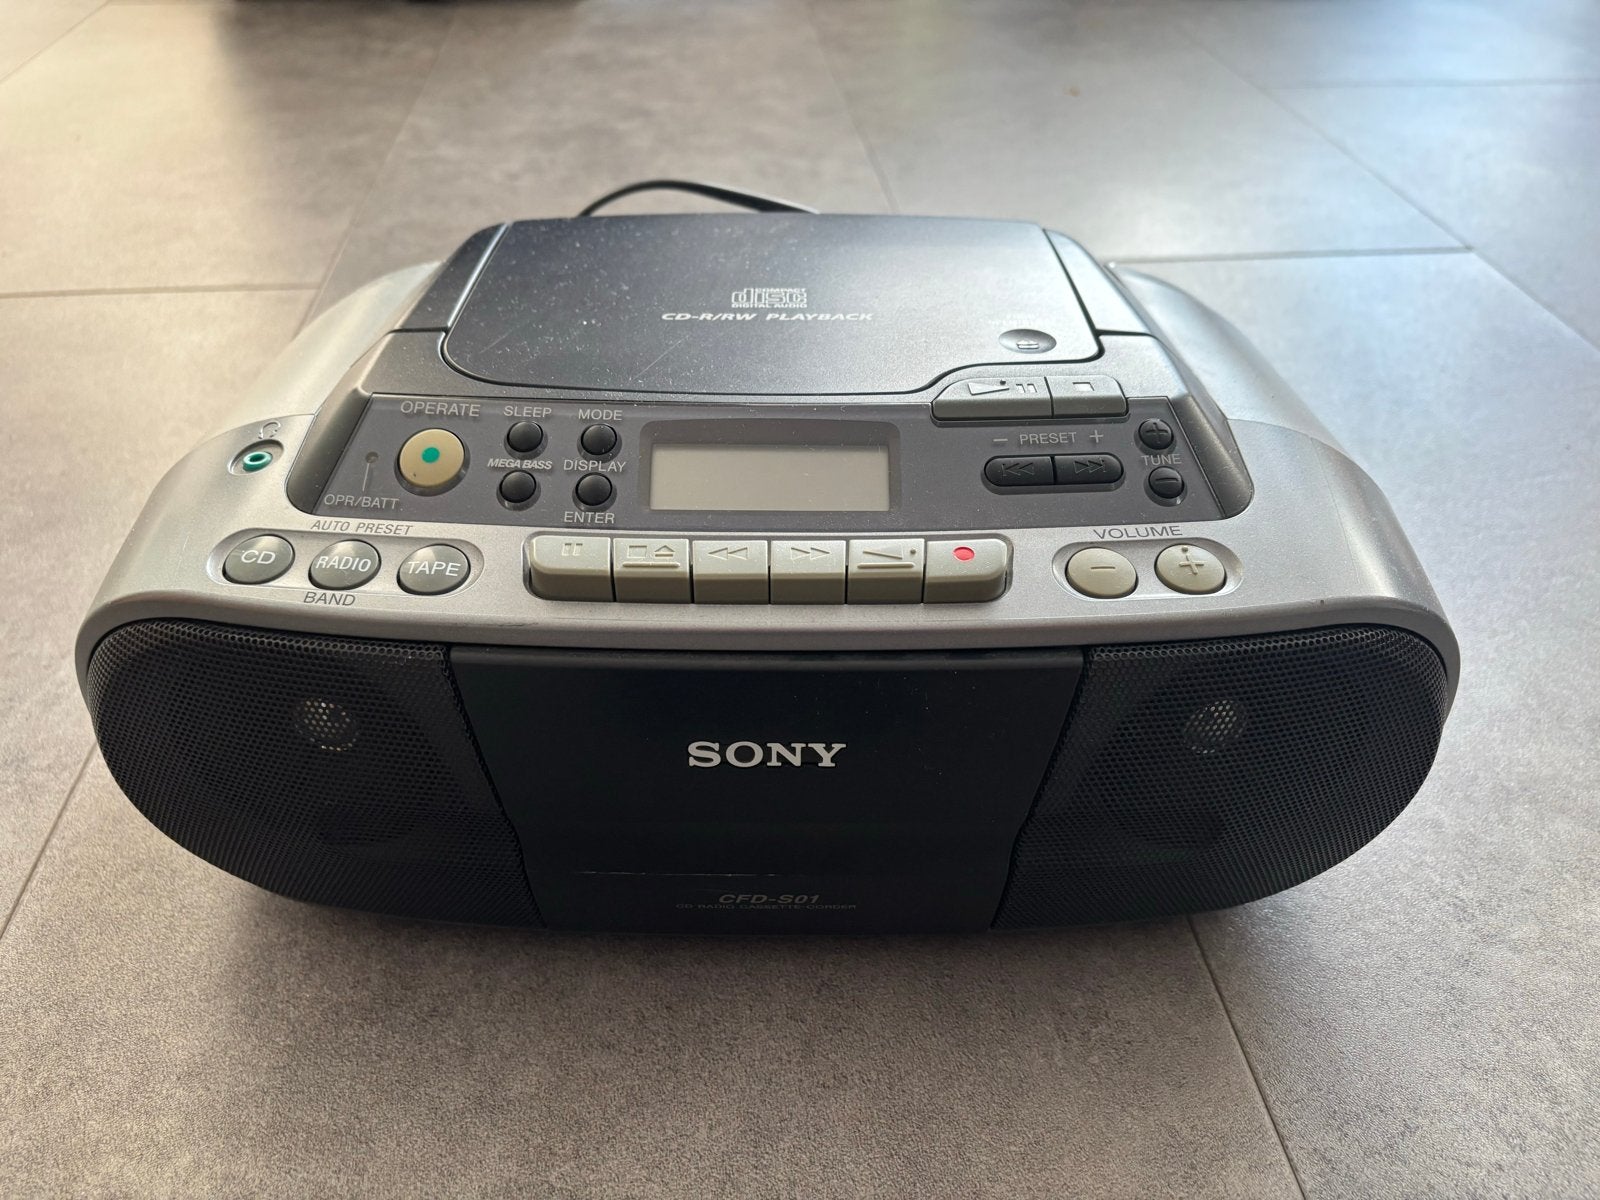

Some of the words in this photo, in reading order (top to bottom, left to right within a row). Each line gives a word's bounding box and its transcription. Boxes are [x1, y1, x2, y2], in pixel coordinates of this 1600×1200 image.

[661, 313, 757, 321] CD-R/RW
[766, 313, 874, 321] PLAYBACK
[400, 401, 481, 417] OPERATE
[503, 405, 552, 418] SLEEP
[578, 409, 623, 421] MODE
[1019, 432, 1077, 445] PRESET
[487, 458, 522, 469] MEGA
[522, 459, 553, 471] BASS
[563, 459, 626, 473] DISPLAY
[1141, 455, 1182, 466] TUNE
[324, 494, 399, 510] OPR/BATT
[563, 511, 615, 524] ENTER
[310, 519, 351, 533] AUTO
[355, 521, 414, 536] PRESET
[1093, 525, 1184, 540] VOLUME
[240, 549, 277, 565] CD
[316, 556, 371, 573] RADIO
[407, 561, 461, 577] TAPE
[303, 591, 356, 606] BAND
[687, 741, 847, 768] SONY
[718, 894, 820, 904] CFD-S01
